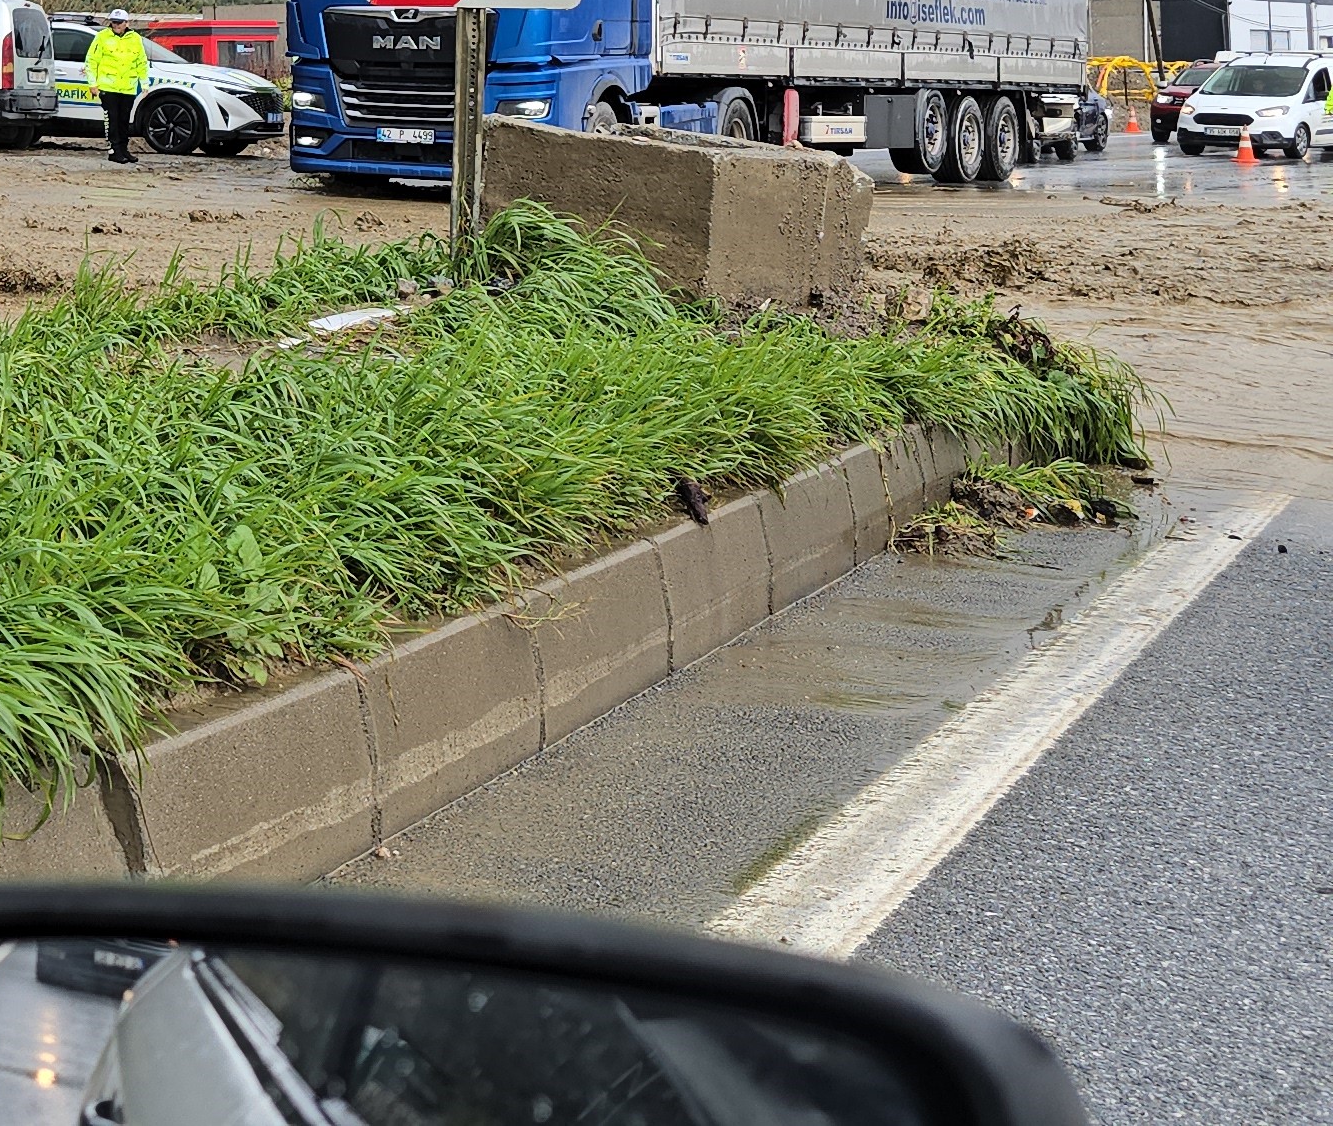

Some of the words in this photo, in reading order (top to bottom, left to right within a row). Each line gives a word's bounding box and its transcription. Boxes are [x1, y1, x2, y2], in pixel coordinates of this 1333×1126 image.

[372, 35, 441, 50] MAN
[56, 87, 88, 100] RAFİK
[381, 129, 392, 139] 42
[399, 129, 405, 139] P
[412, 130, 434, 141] 4499
